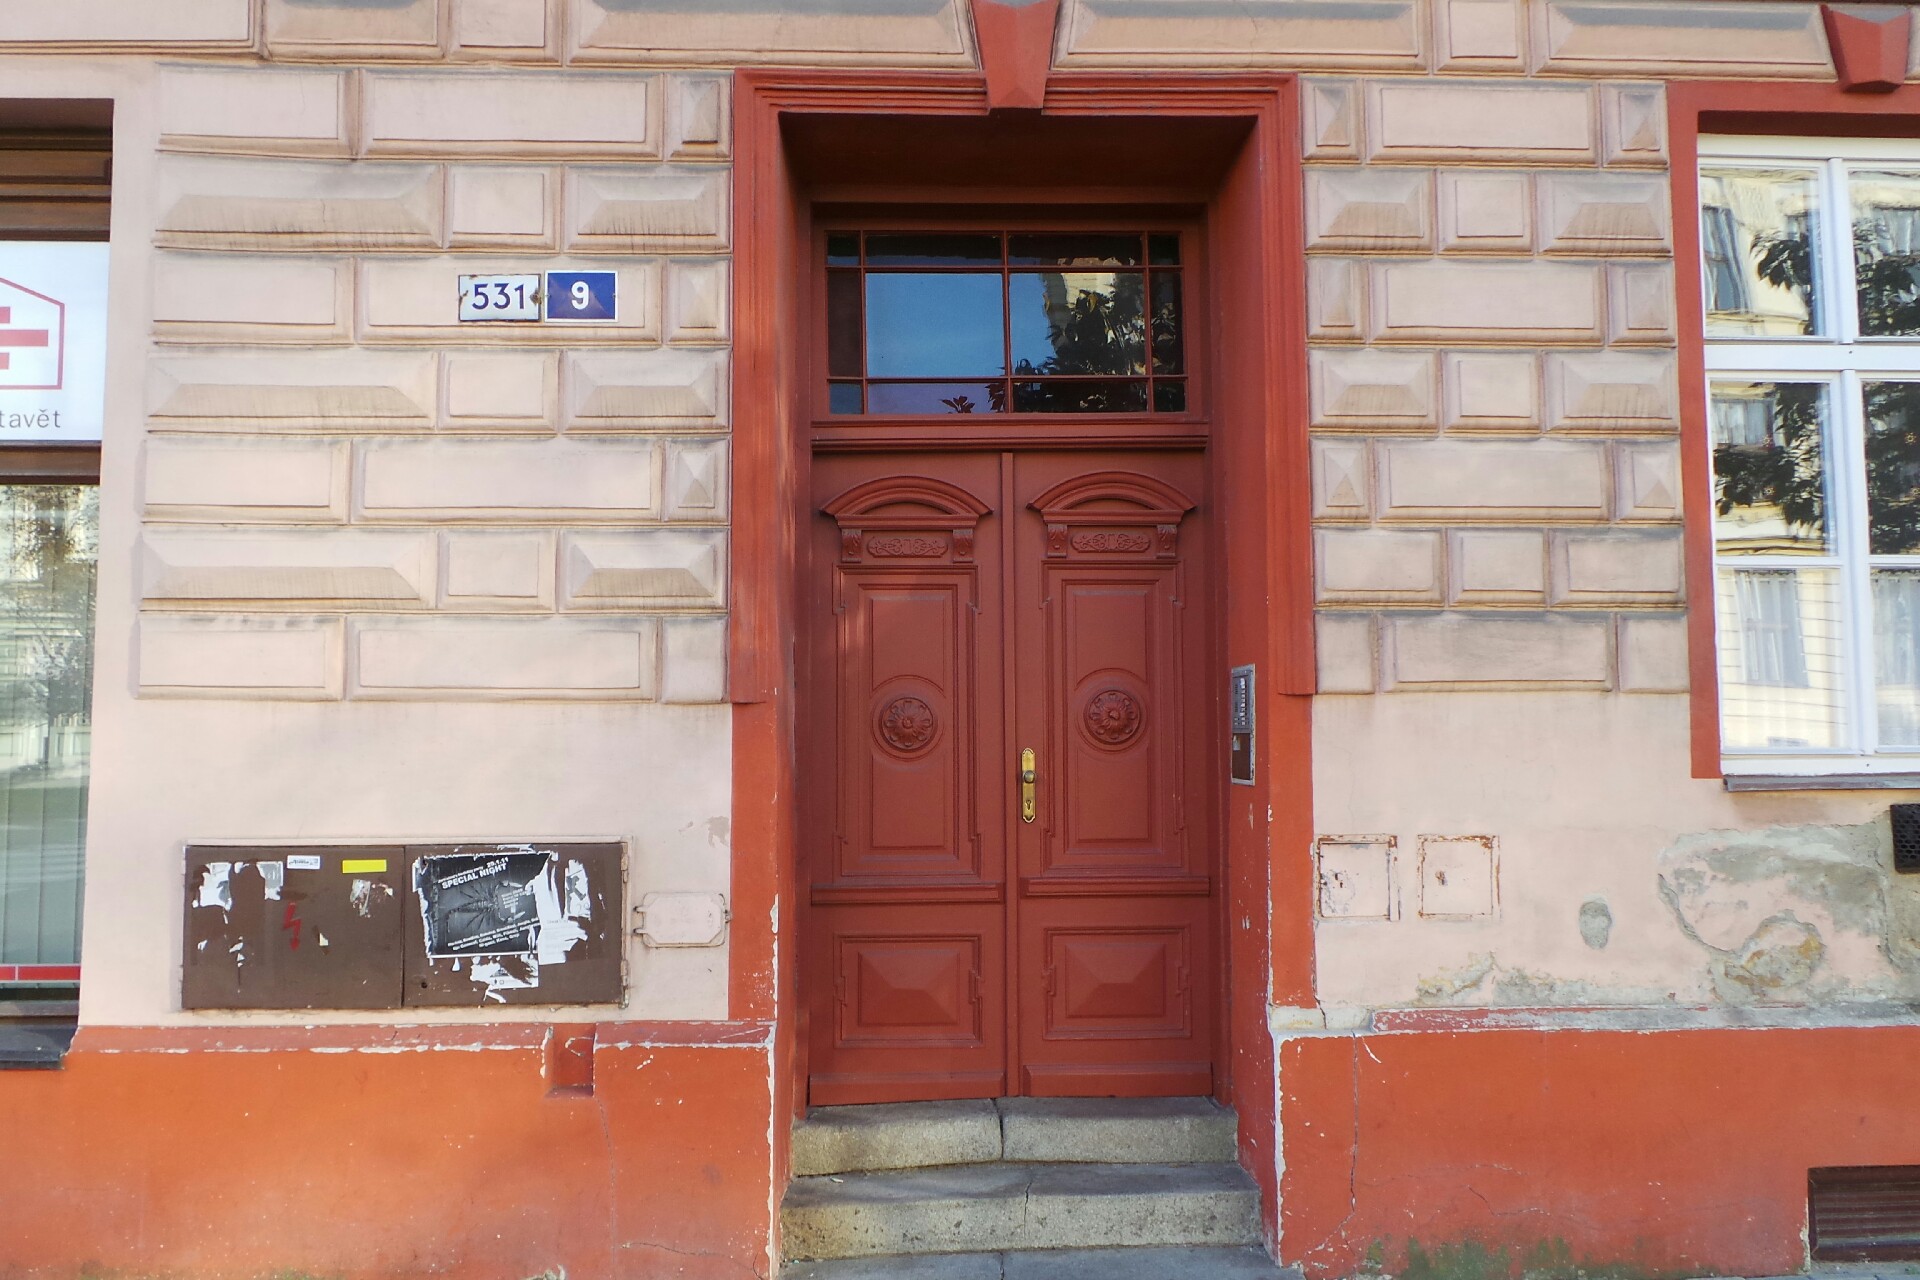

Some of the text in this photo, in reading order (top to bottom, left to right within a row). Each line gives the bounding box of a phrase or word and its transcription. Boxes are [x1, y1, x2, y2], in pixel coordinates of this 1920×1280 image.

[472, 283, 524, 310] 531
[571, 280, 590, 310] 9
[441, 872, 479, 890] SPECIAL
[480, 862, 507, 878] NIGHT
